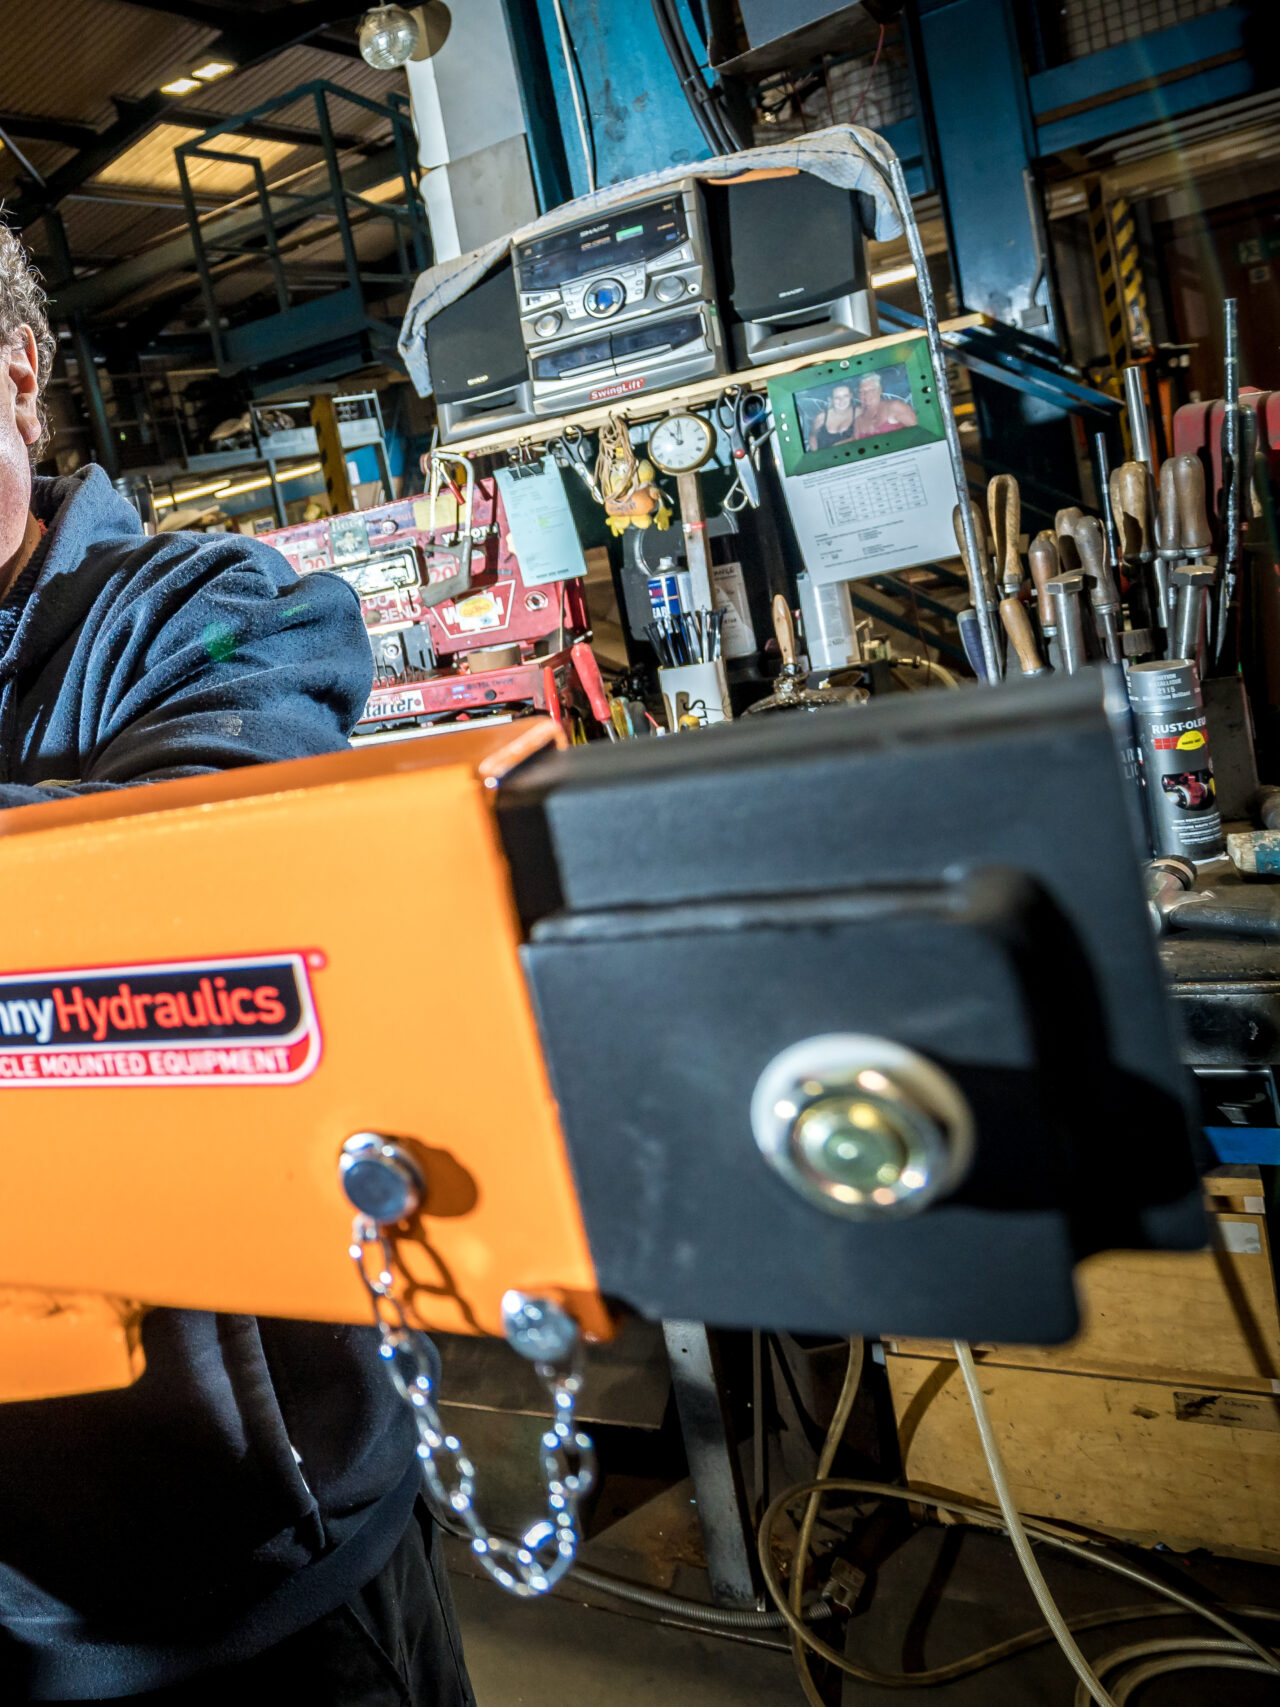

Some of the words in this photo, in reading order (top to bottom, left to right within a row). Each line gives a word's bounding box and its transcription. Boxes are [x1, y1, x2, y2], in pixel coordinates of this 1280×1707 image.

[591, 379, 642, 400] SwingLift
[362, 696, 414, 720] tarter
[39, 1052, 147, 1078] MOUNTED
[149, 1047, 292, 1075] EQUIPMENT
